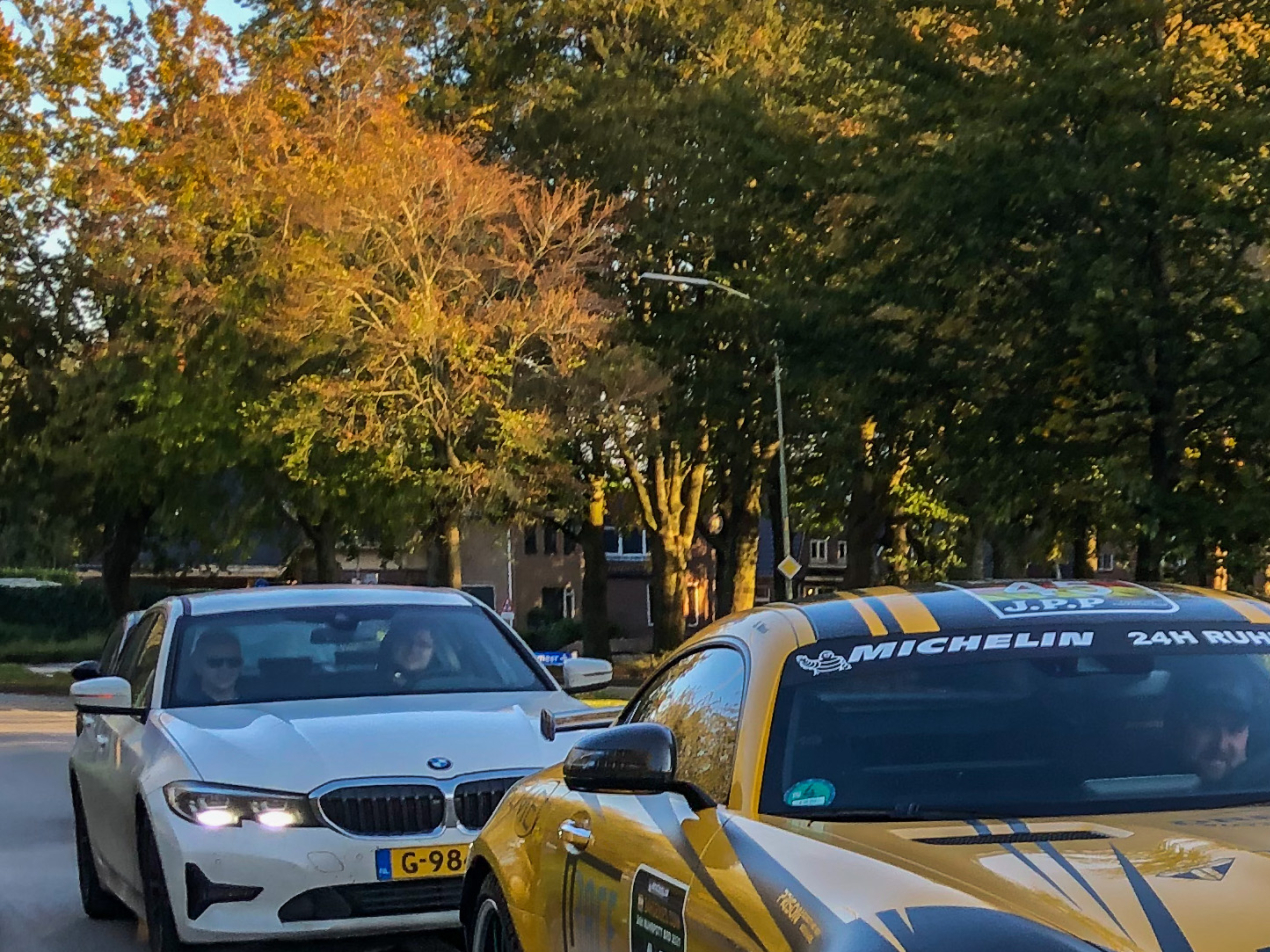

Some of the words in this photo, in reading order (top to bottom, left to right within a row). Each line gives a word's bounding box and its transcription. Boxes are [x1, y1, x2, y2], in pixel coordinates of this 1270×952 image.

[1004, 597, 1105, 613] J.P.P
[848, 631, 1094, 663] MICHELIN
[1130, 631, 1196, 647] 24H
[402, 849, 467, 874] G-98
